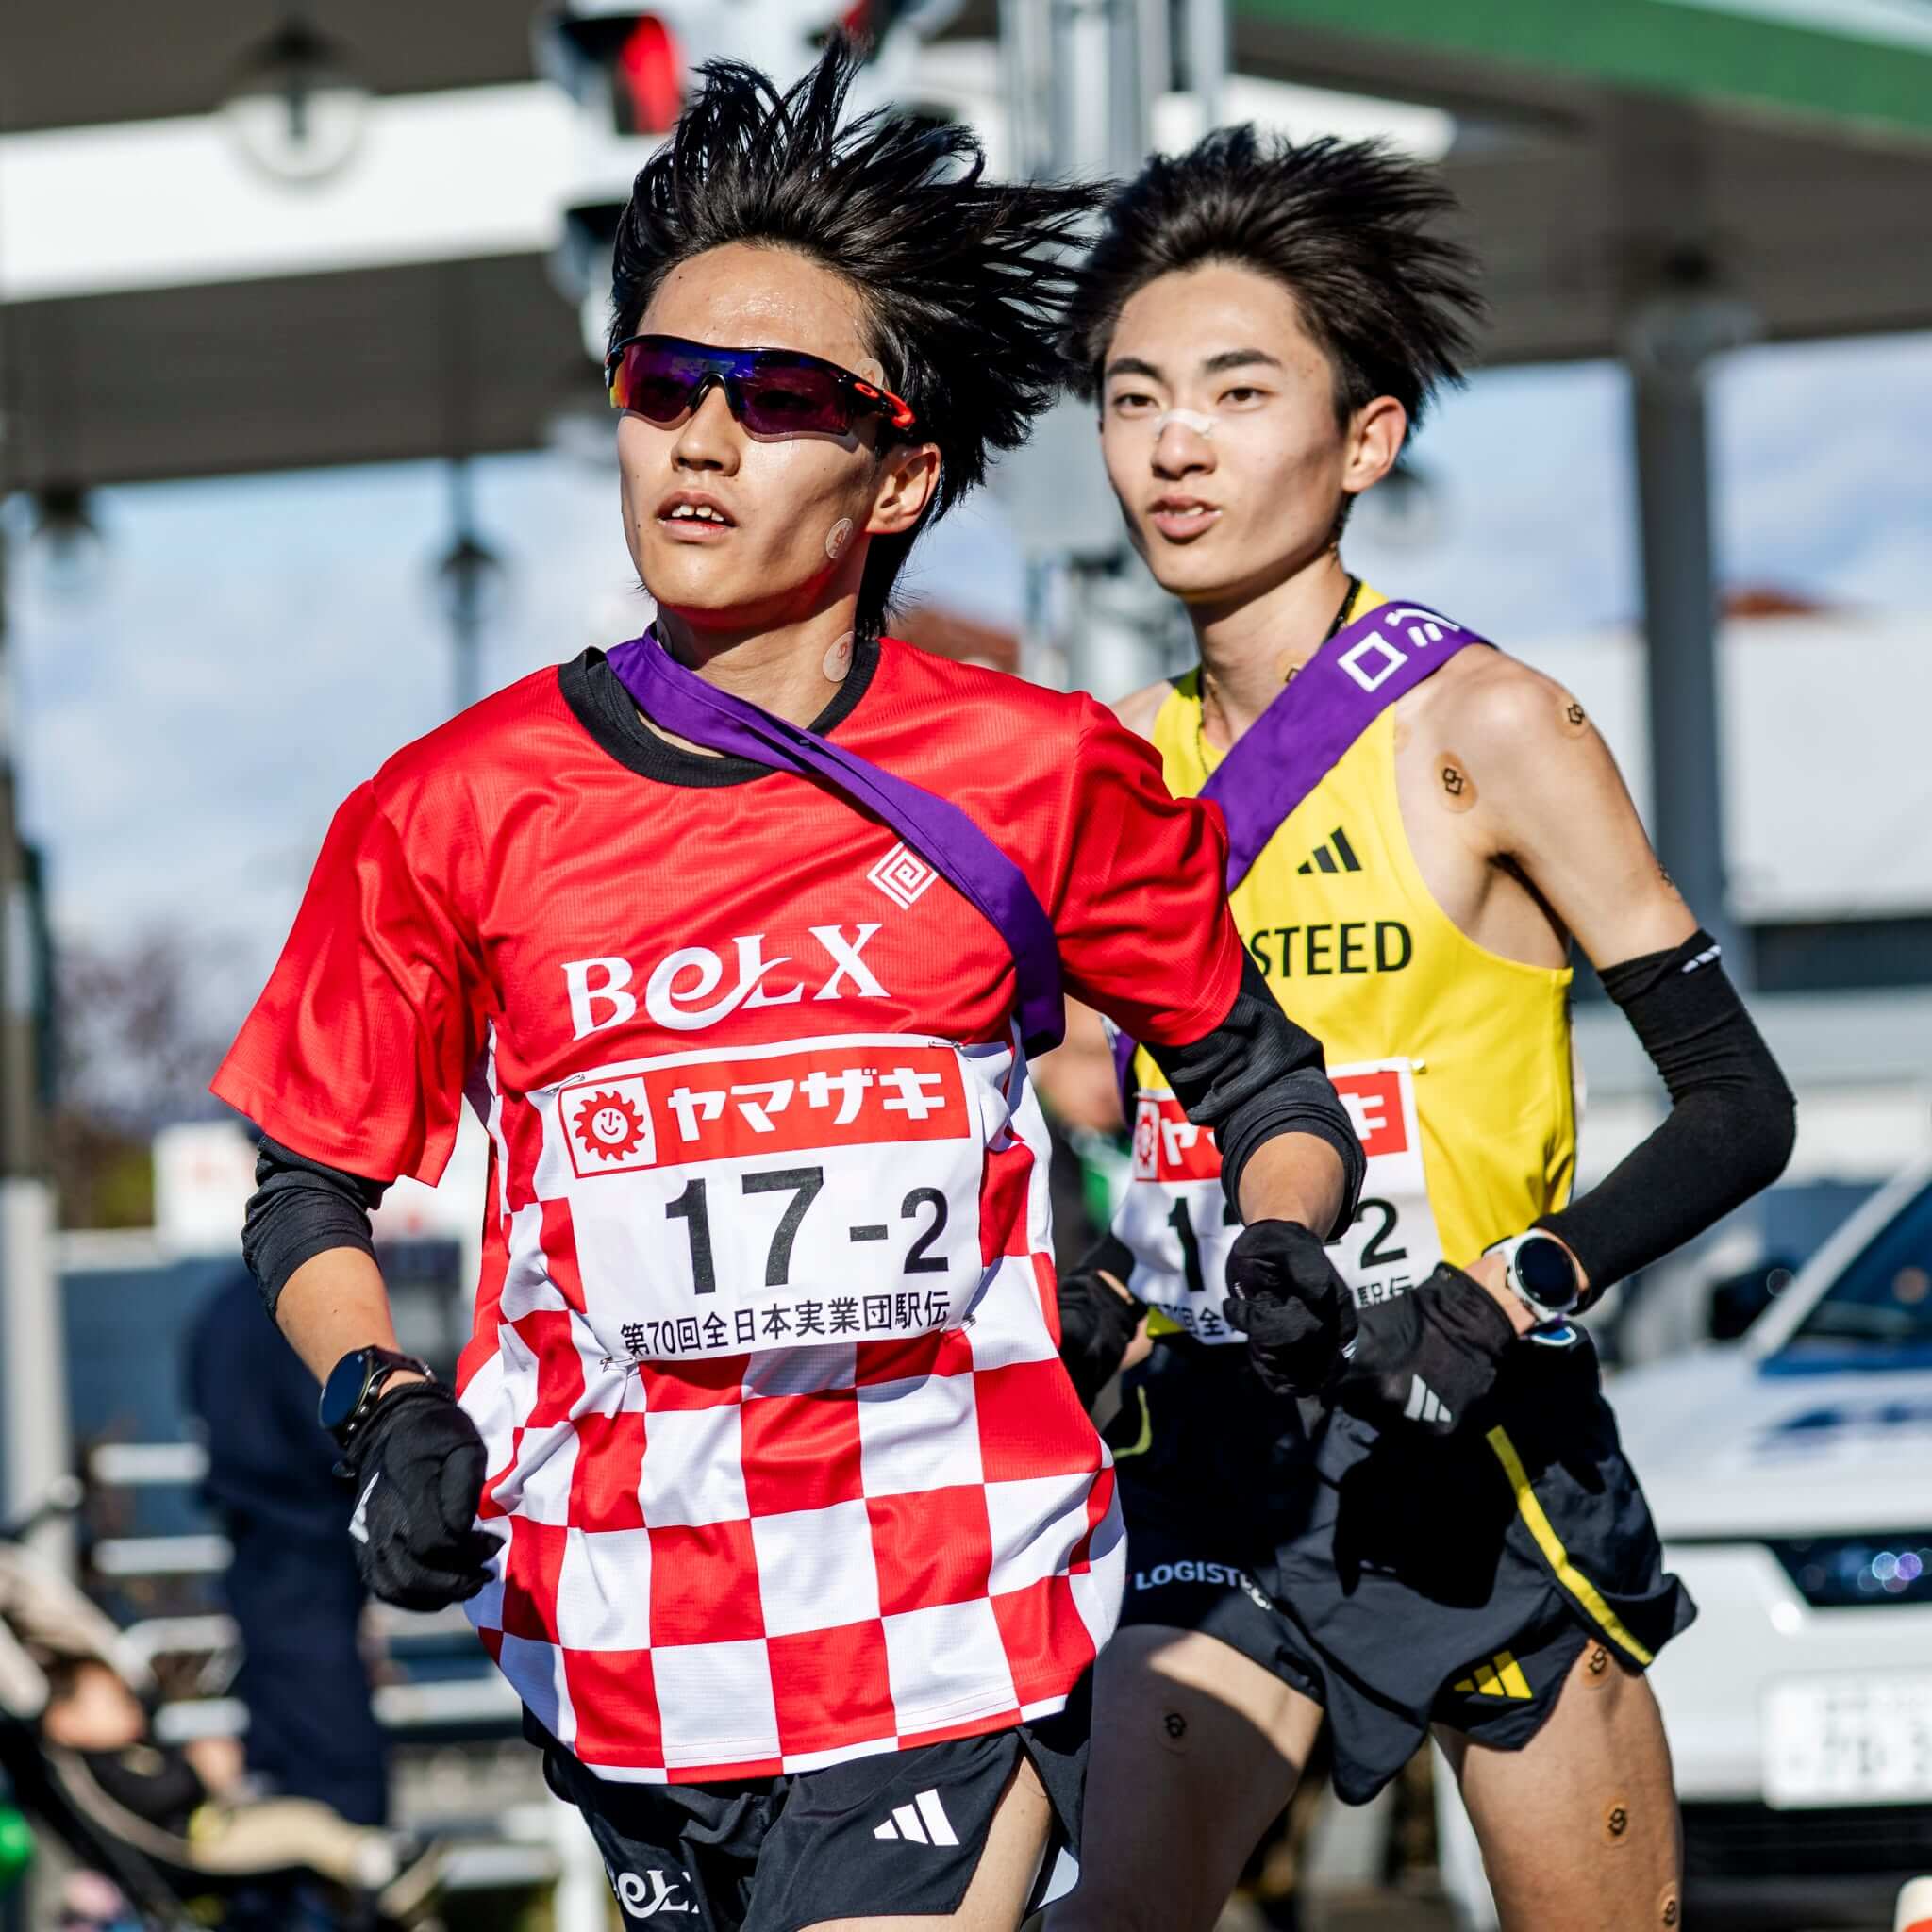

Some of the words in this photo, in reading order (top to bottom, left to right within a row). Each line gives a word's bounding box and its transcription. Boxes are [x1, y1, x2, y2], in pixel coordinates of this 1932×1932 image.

[667, 1067, 945, 1142] ヤマザキ
[665, 1166, 950, 1295] 17-2
[620, 1290, 951, 1357] 第70回全日本実業団駅伝
[1135, 1560, 1273, 1611] LOGIST
